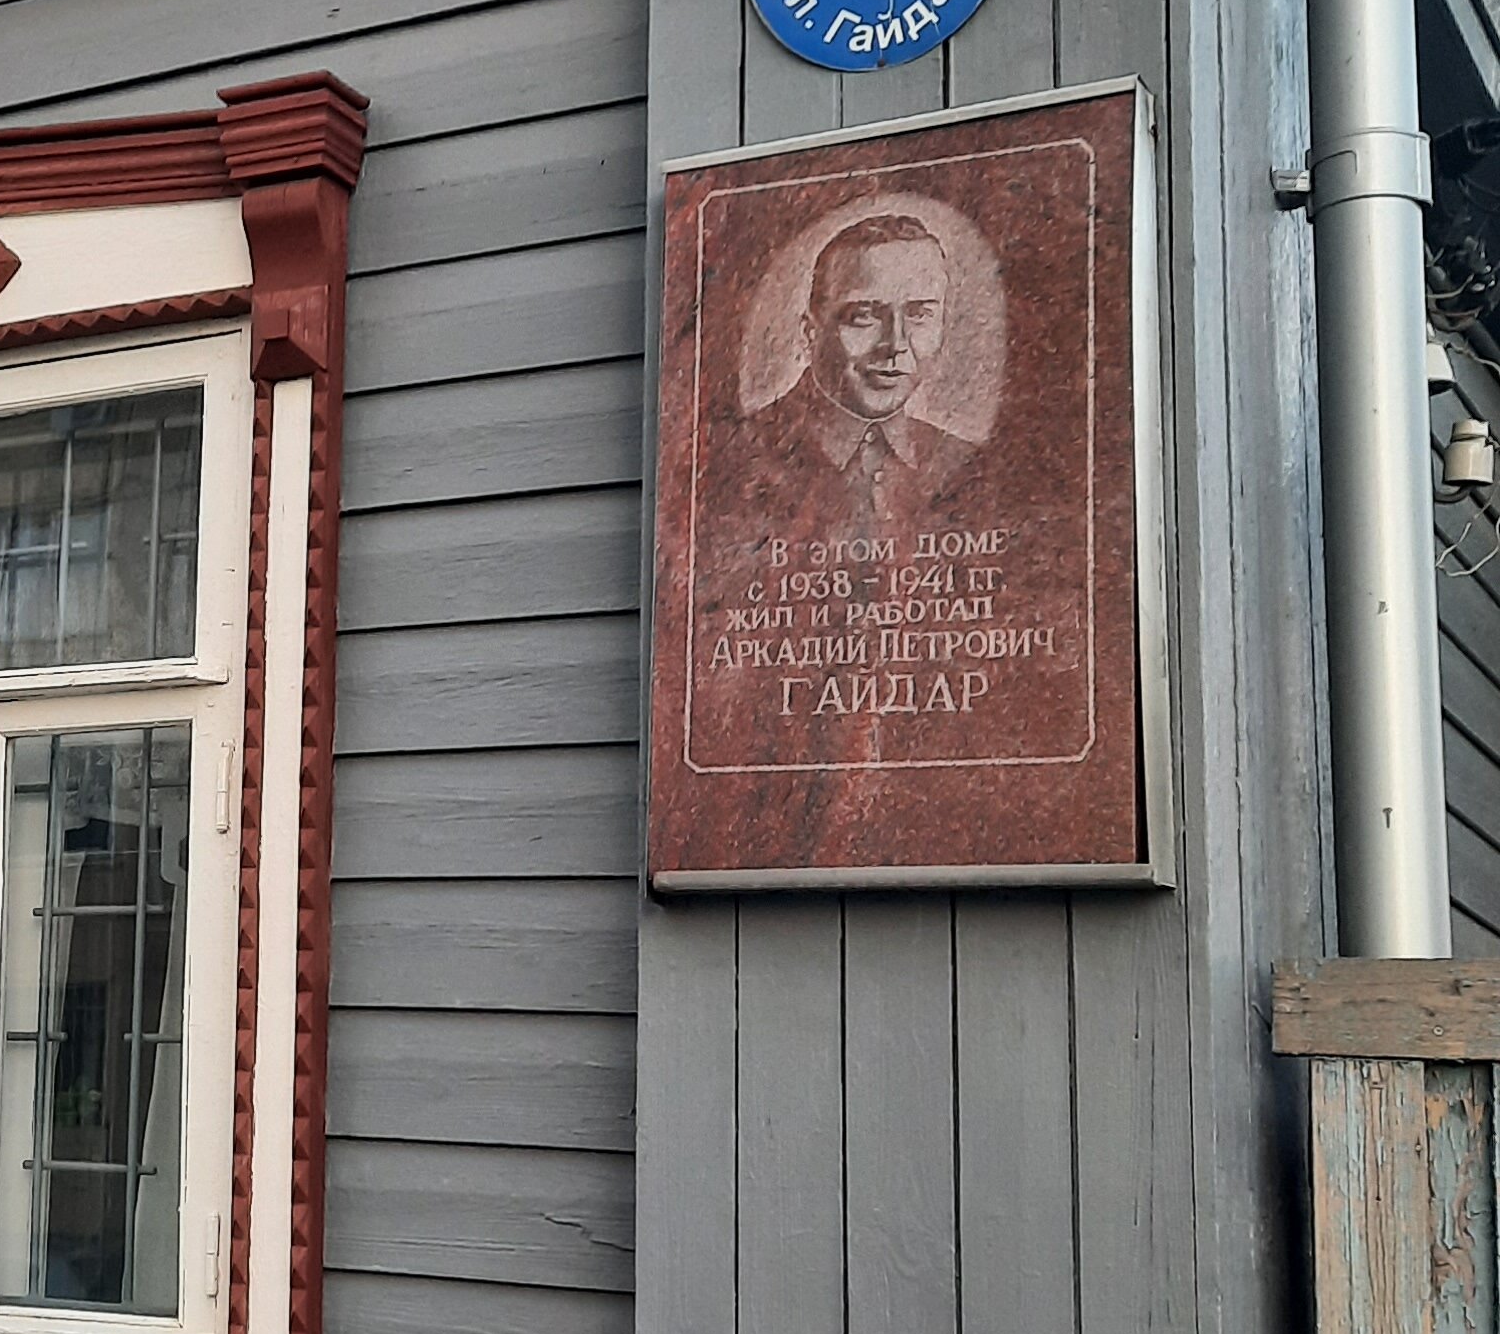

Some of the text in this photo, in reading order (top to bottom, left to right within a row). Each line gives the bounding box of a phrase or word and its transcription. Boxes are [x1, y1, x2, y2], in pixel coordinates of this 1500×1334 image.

[770, 529, 1010, 567] В ЭТОМ ДОМЕ
[778, 570, 853, 603] 1938
[888, 564, 955, 596] 1941
[725, 595, 995, 632] ЖИЛ И РАБОТАЛ
[708, 626, 1057, 669] АРКАДИЙ ПЕТРОВИЧ
[778, 666, 990, 716] ГАЙДАР
